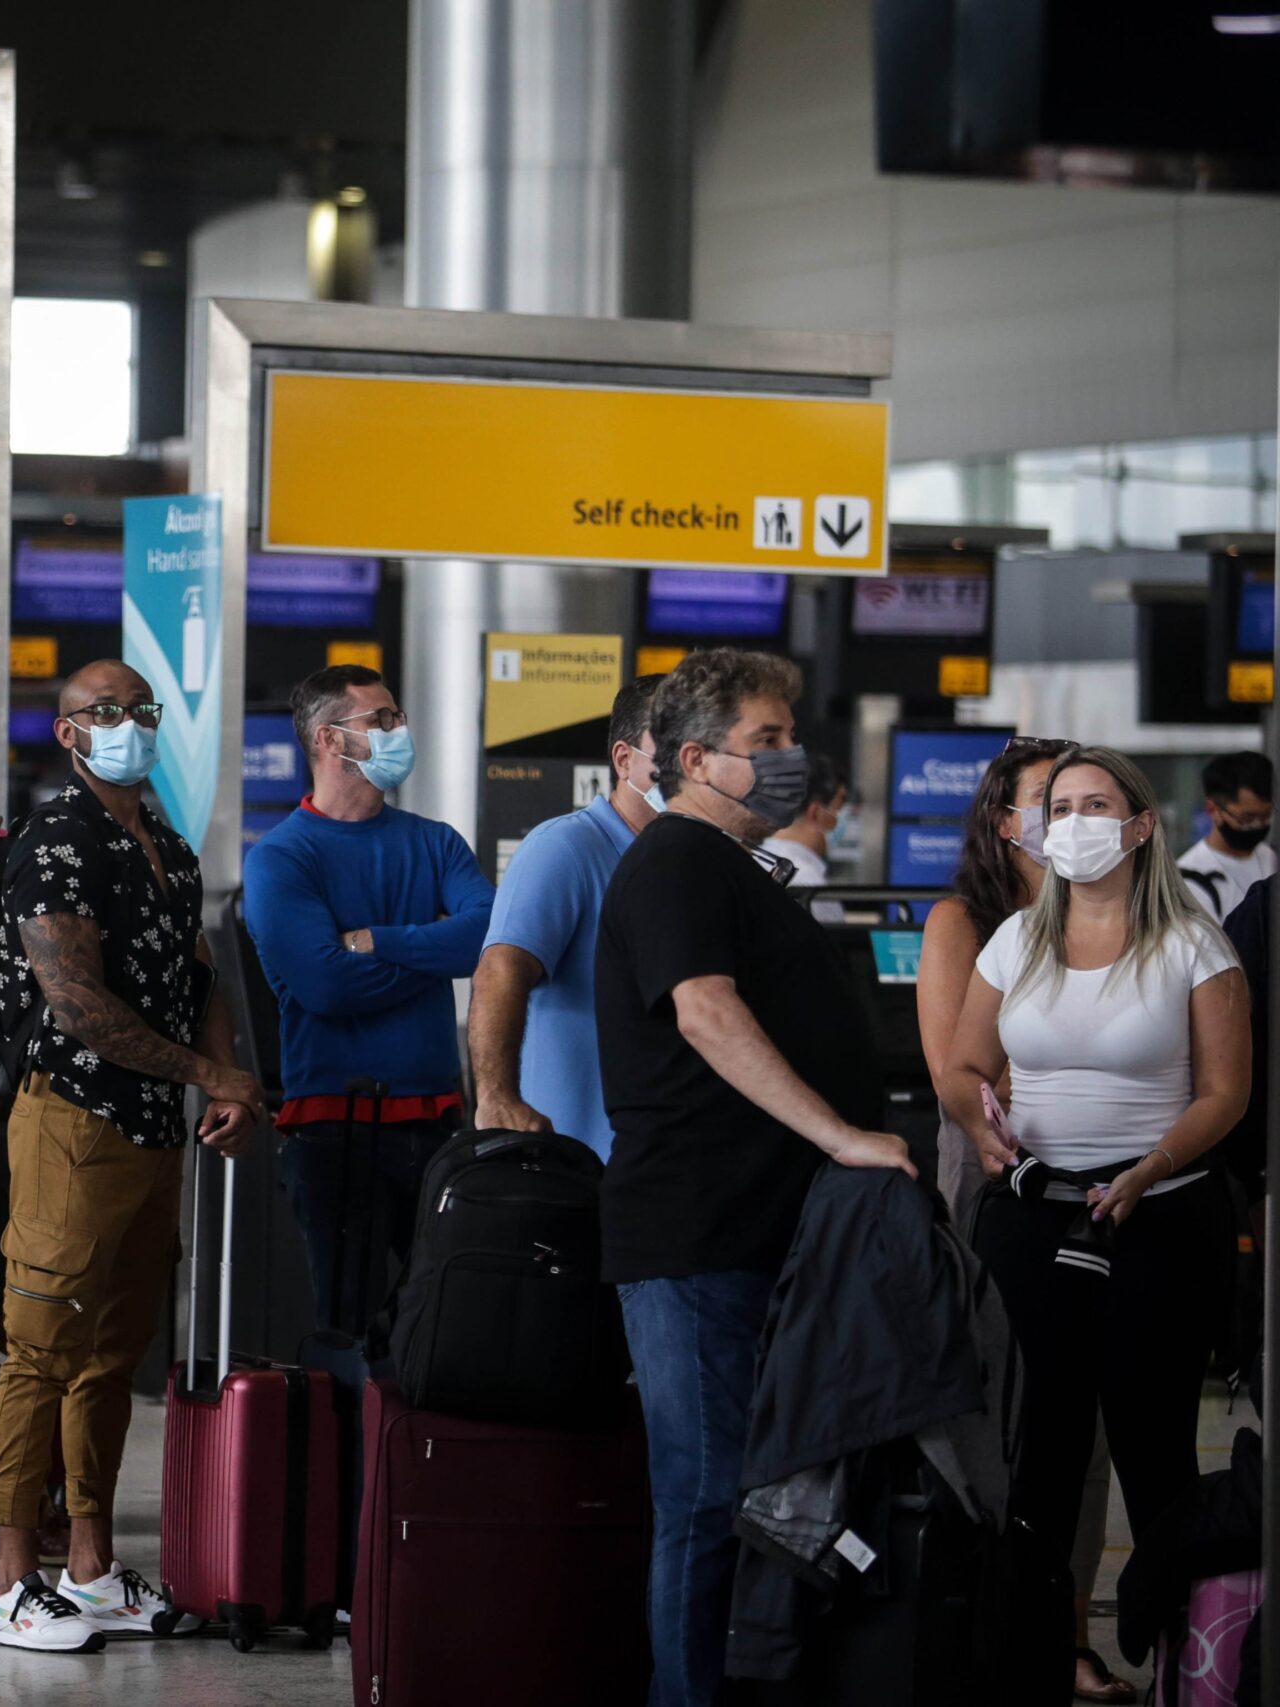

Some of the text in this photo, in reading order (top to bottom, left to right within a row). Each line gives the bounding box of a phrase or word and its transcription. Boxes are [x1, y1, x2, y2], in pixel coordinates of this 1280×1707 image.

[573, 498, 740, 531] Self check-in
[147, 546, 187, 574] Hand
[521, 647, 616, 666] Informações
[521, 667, 612, 684] Information
[487, 765, 542, 780] Check-in
